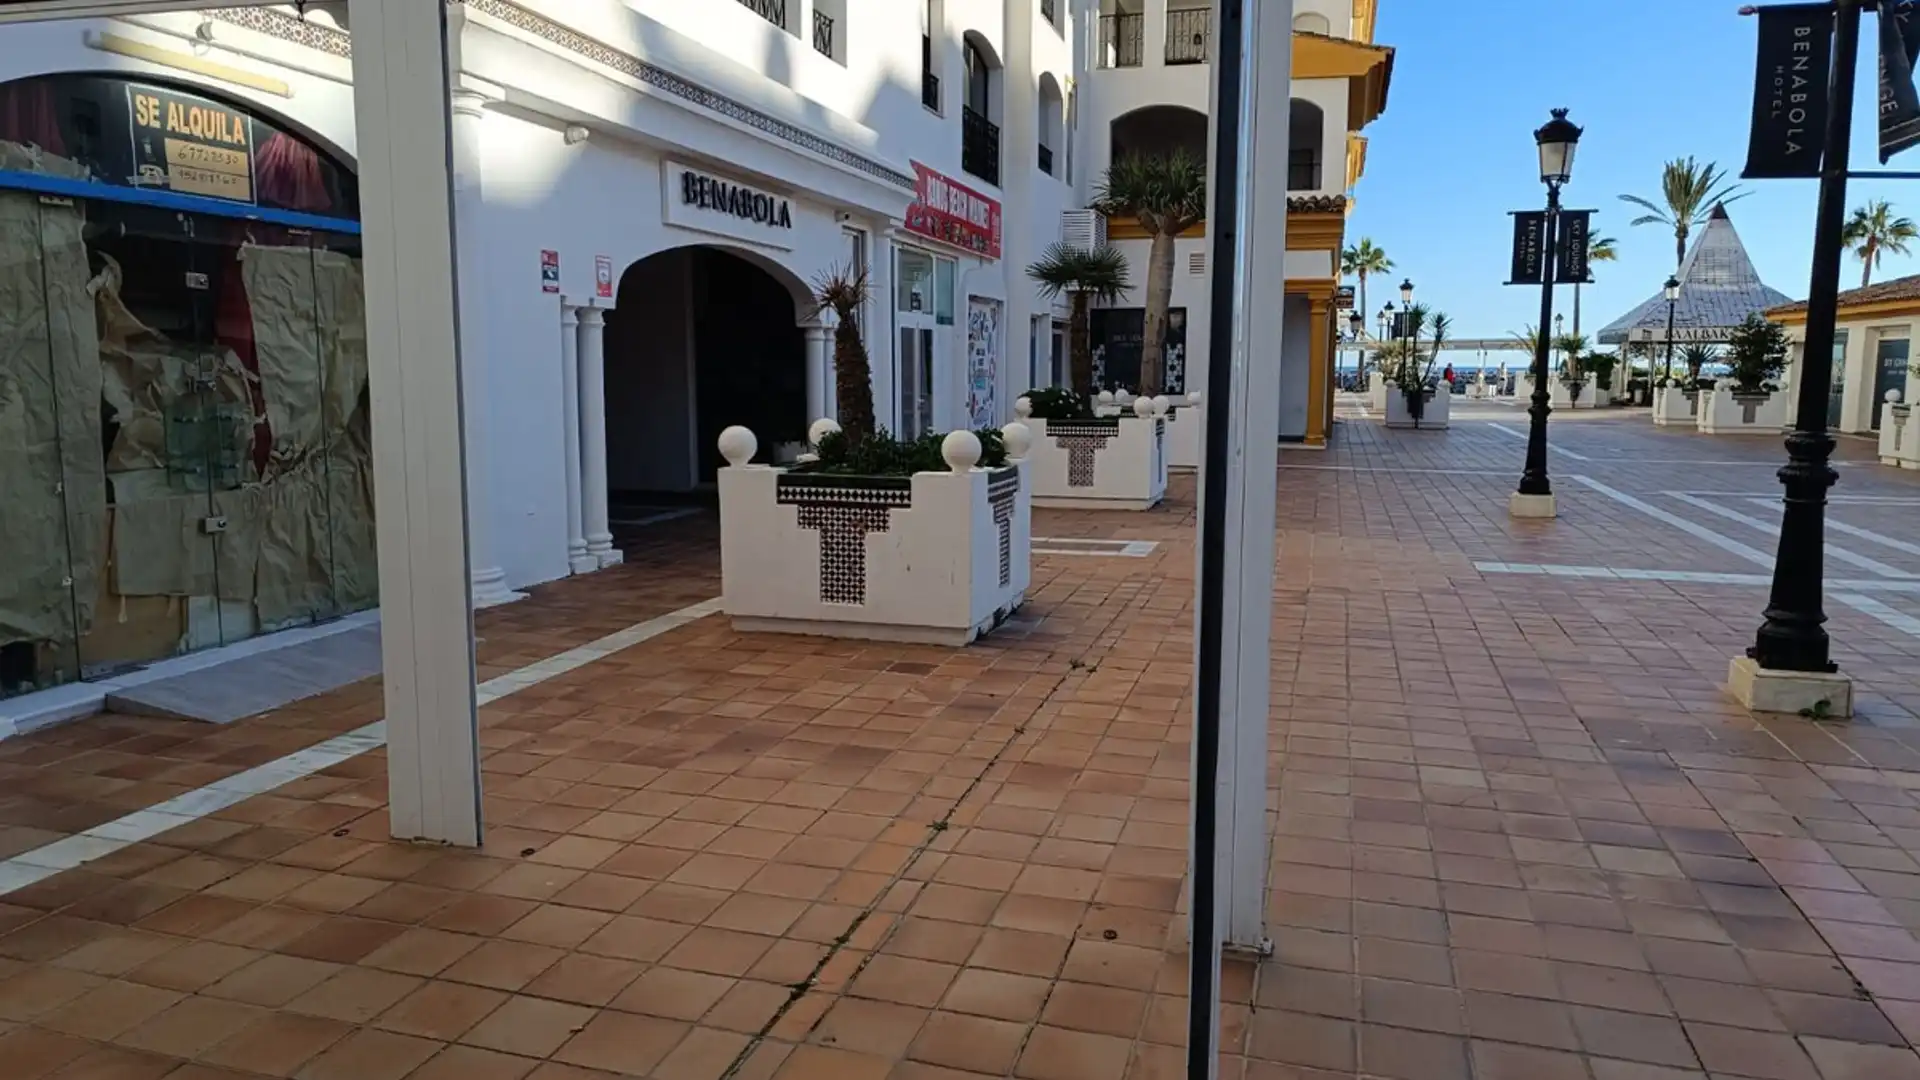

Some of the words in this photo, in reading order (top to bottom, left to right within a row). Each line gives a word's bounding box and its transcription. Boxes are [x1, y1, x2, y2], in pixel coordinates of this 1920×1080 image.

[1771, 65, 1785, 118] HOTEL
[1785, 26, 1811, 155] BENABOLA
[135, 94, 161, 129] SE
[166, 101, 246, 145] ALQUILA
[682, 171, 792, 229] BENABOLA
[1526, 219, 1538, 275] BENABOLA
